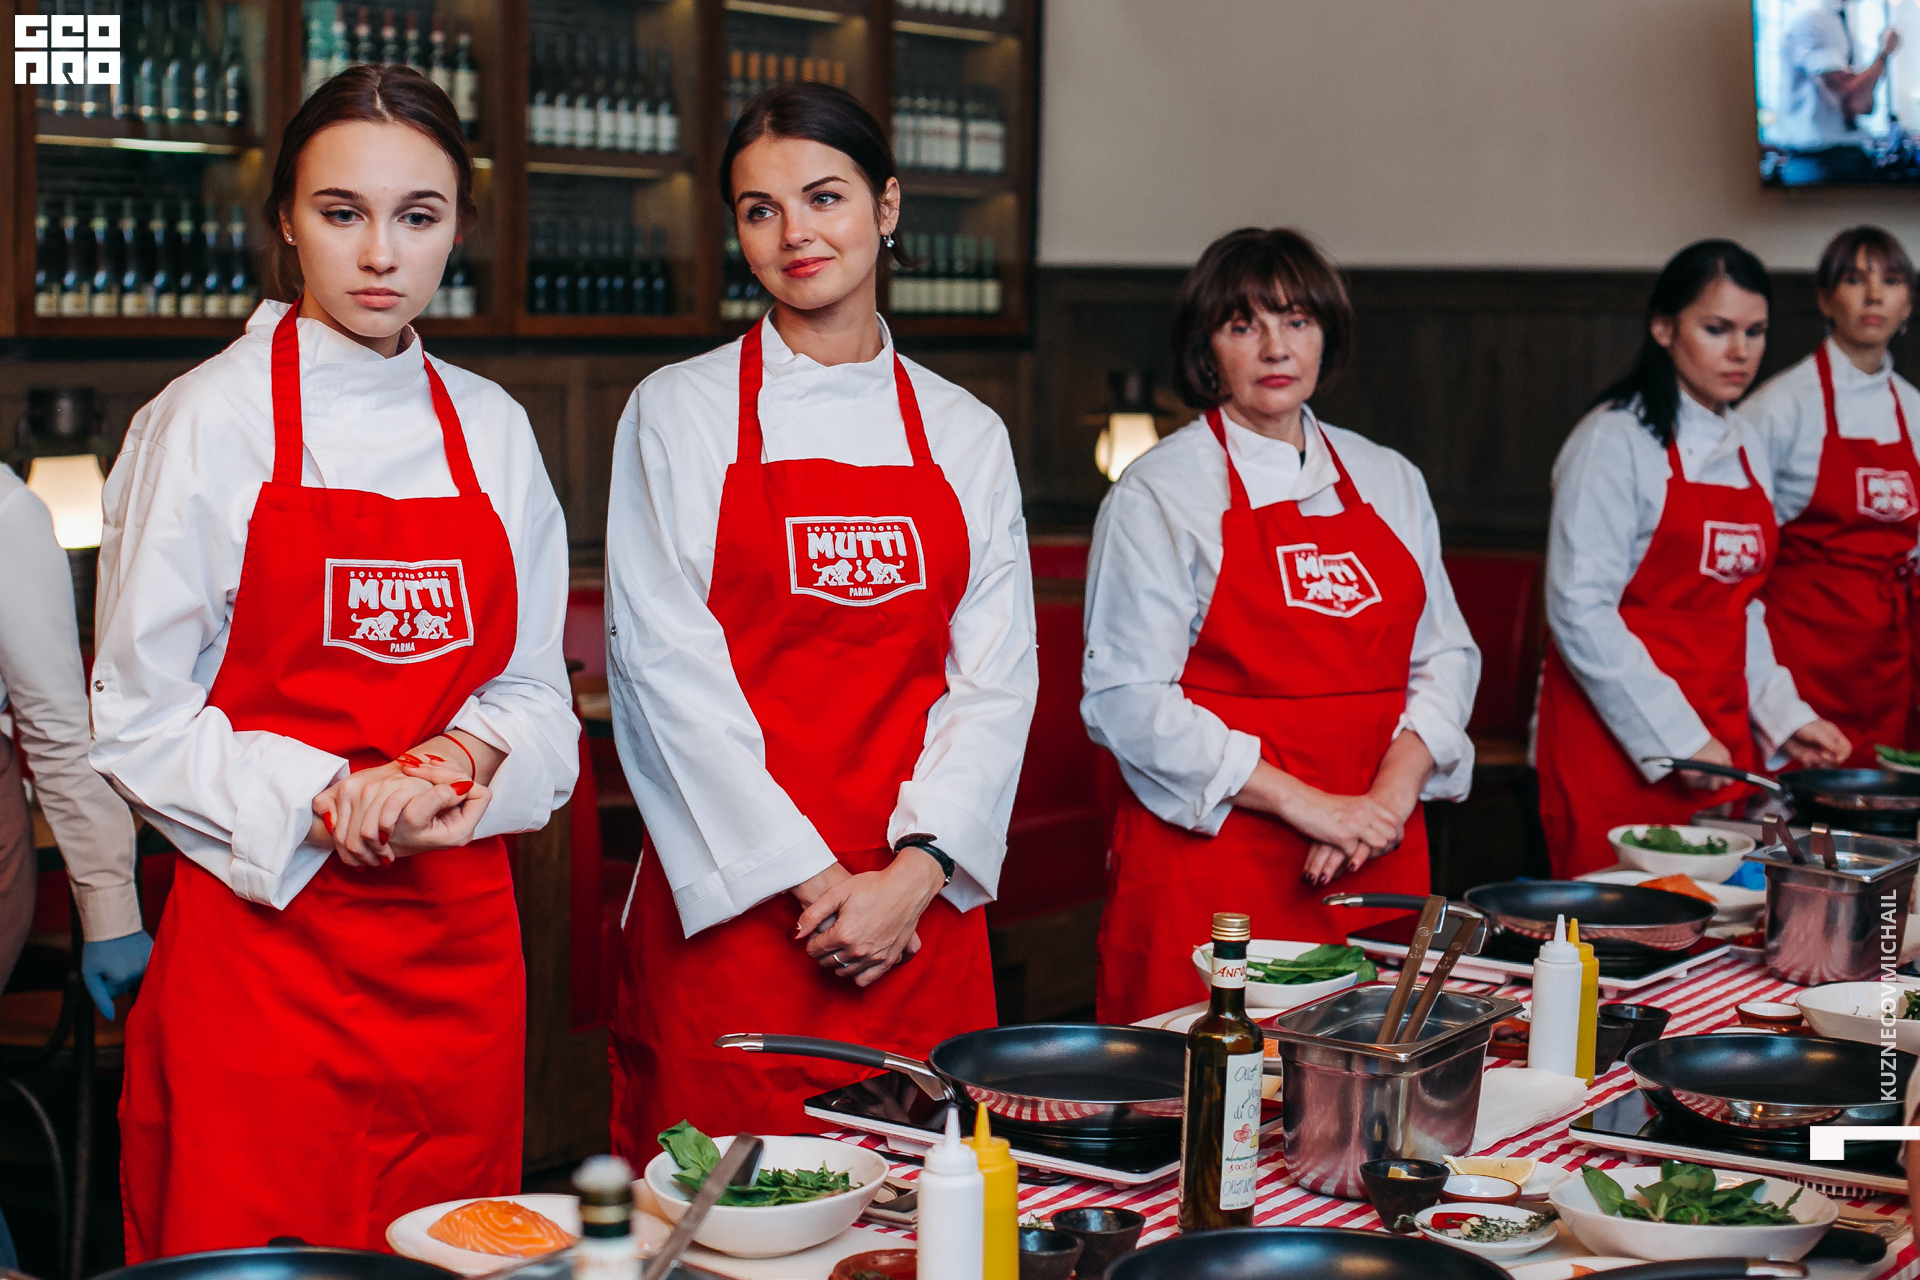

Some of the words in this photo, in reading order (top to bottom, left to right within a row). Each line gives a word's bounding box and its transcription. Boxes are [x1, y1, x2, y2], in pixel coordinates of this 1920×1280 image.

[807, 531, 907, 559] MUTTI
[348, 578, 454, 610] MUTTI
[849, 587, 873, 597] PARMA
[390, 642, 415, 653] PARMA
